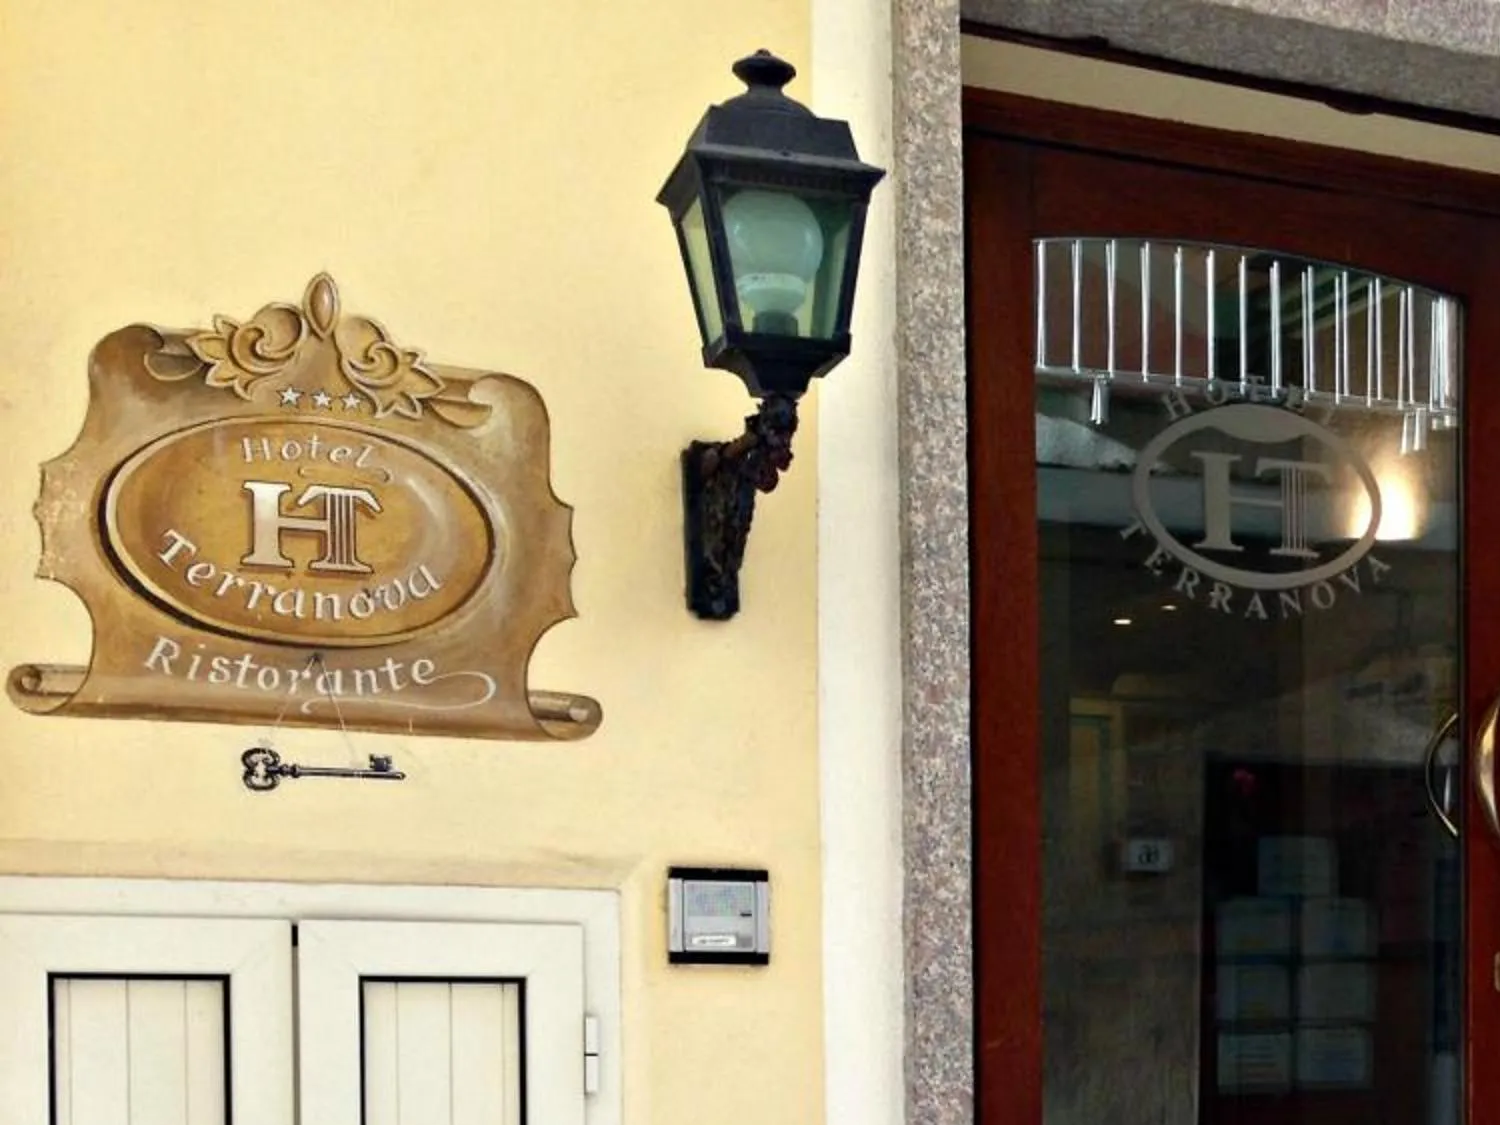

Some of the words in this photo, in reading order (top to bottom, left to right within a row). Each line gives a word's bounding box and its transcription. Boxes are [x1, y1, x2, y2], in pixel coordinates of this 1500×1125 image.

[241, 435, 376, 468] Hotel
[157, 528, 444, 620] Terranova
[1120, 520, 1392, 620] TERRANOVA
[144, 636, 437, 698] Ristorante
